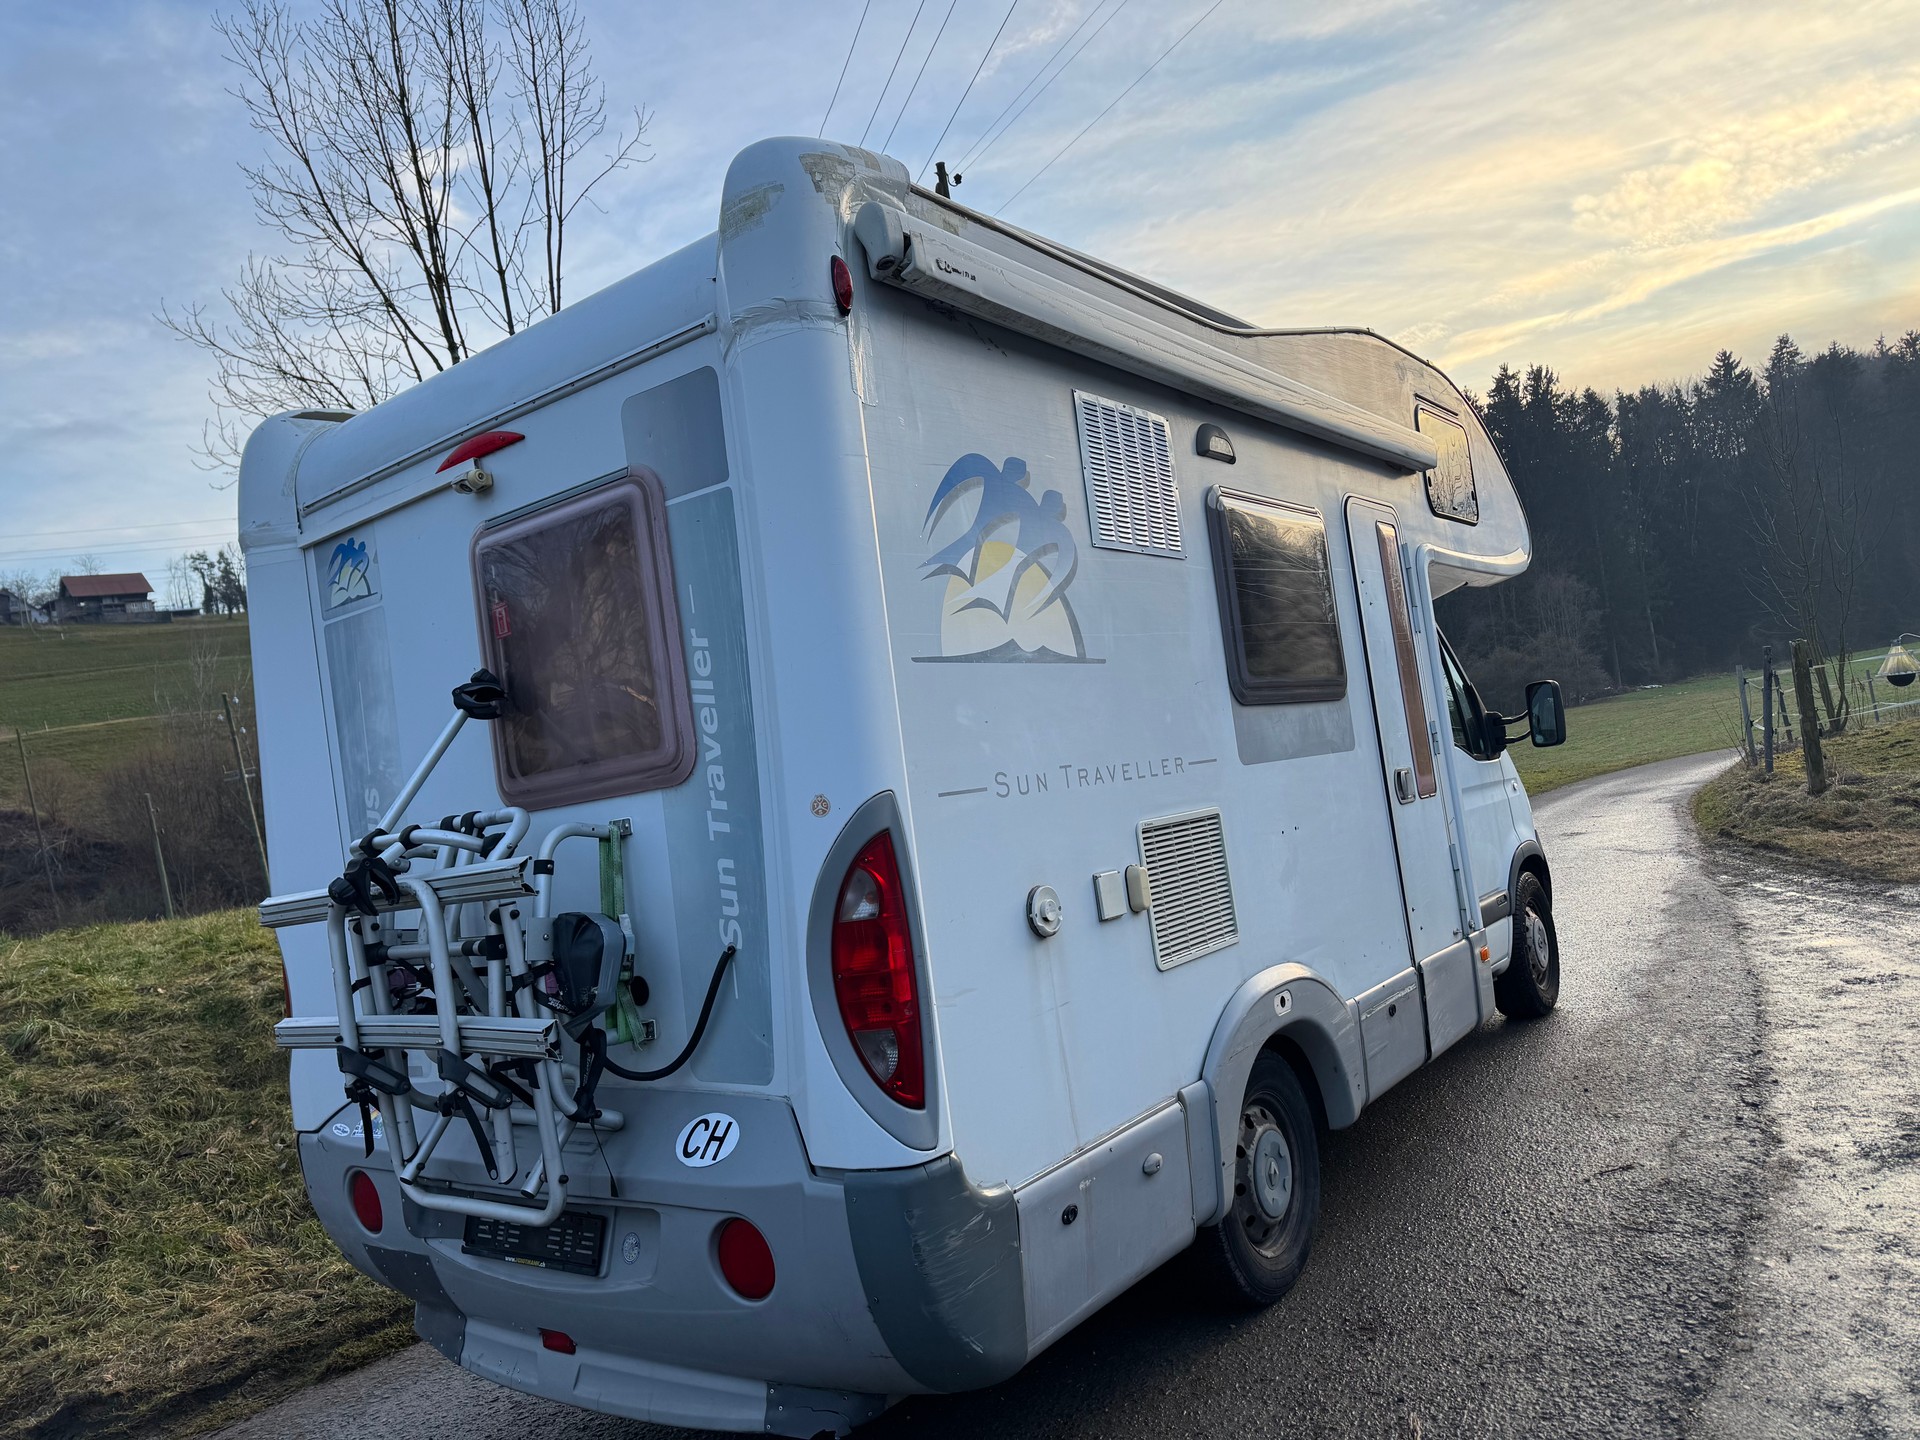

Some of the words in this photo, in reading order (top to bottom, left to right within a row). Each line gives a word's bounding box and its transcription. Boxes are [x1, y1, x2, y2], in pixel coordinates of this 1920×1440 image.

[689, 628, 731, 841] Traveller
[718, 857, 743, 950] Sun
[682, 1118, 734, 1162] CH
